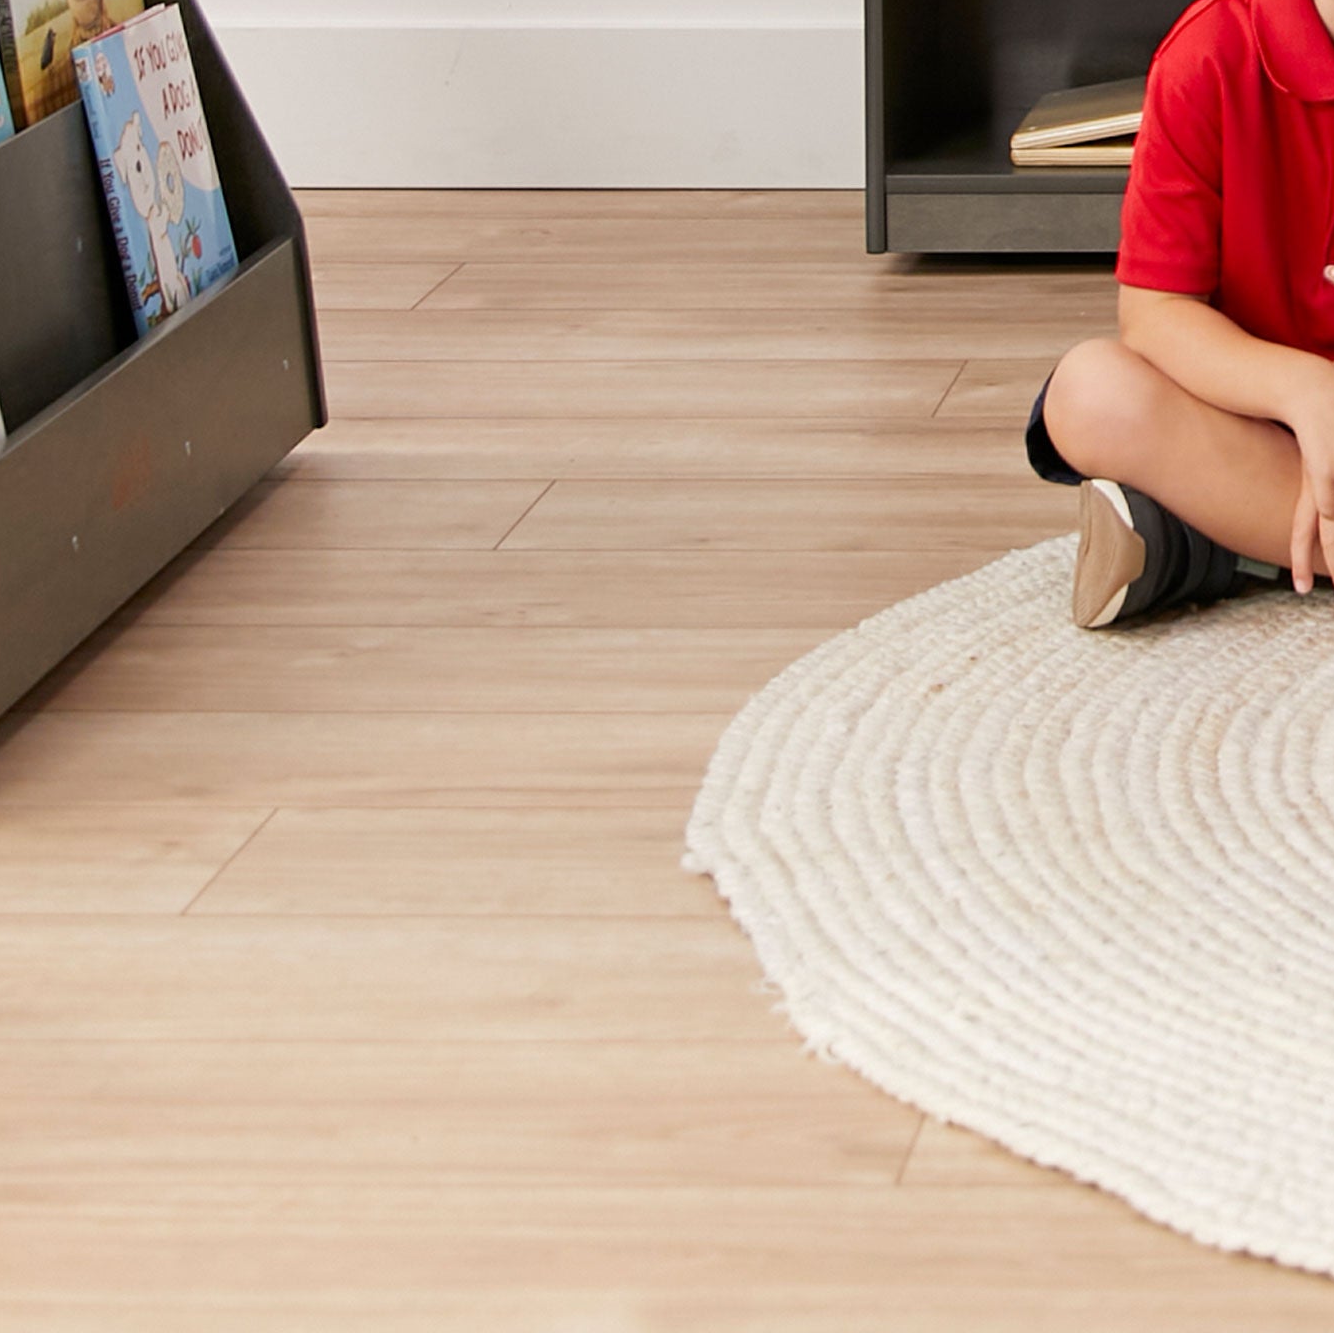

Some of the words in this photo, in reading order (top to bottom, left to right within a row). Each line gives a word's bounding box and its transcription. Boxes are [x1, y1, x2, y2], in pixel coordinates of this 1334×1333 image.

[134, 45, 146, 81] IF
[146, 41, 166, 72] YOU
[162, 88, 171, 120] A
[169, 80, 191, 114] DOG
[99, 158, 111, 169] If
[102, 168, 116, 195] You
[107, 195, 122, 225] Give
[117, 233, 130, 260] Dog
[126, 273, 144, 312] Donut
